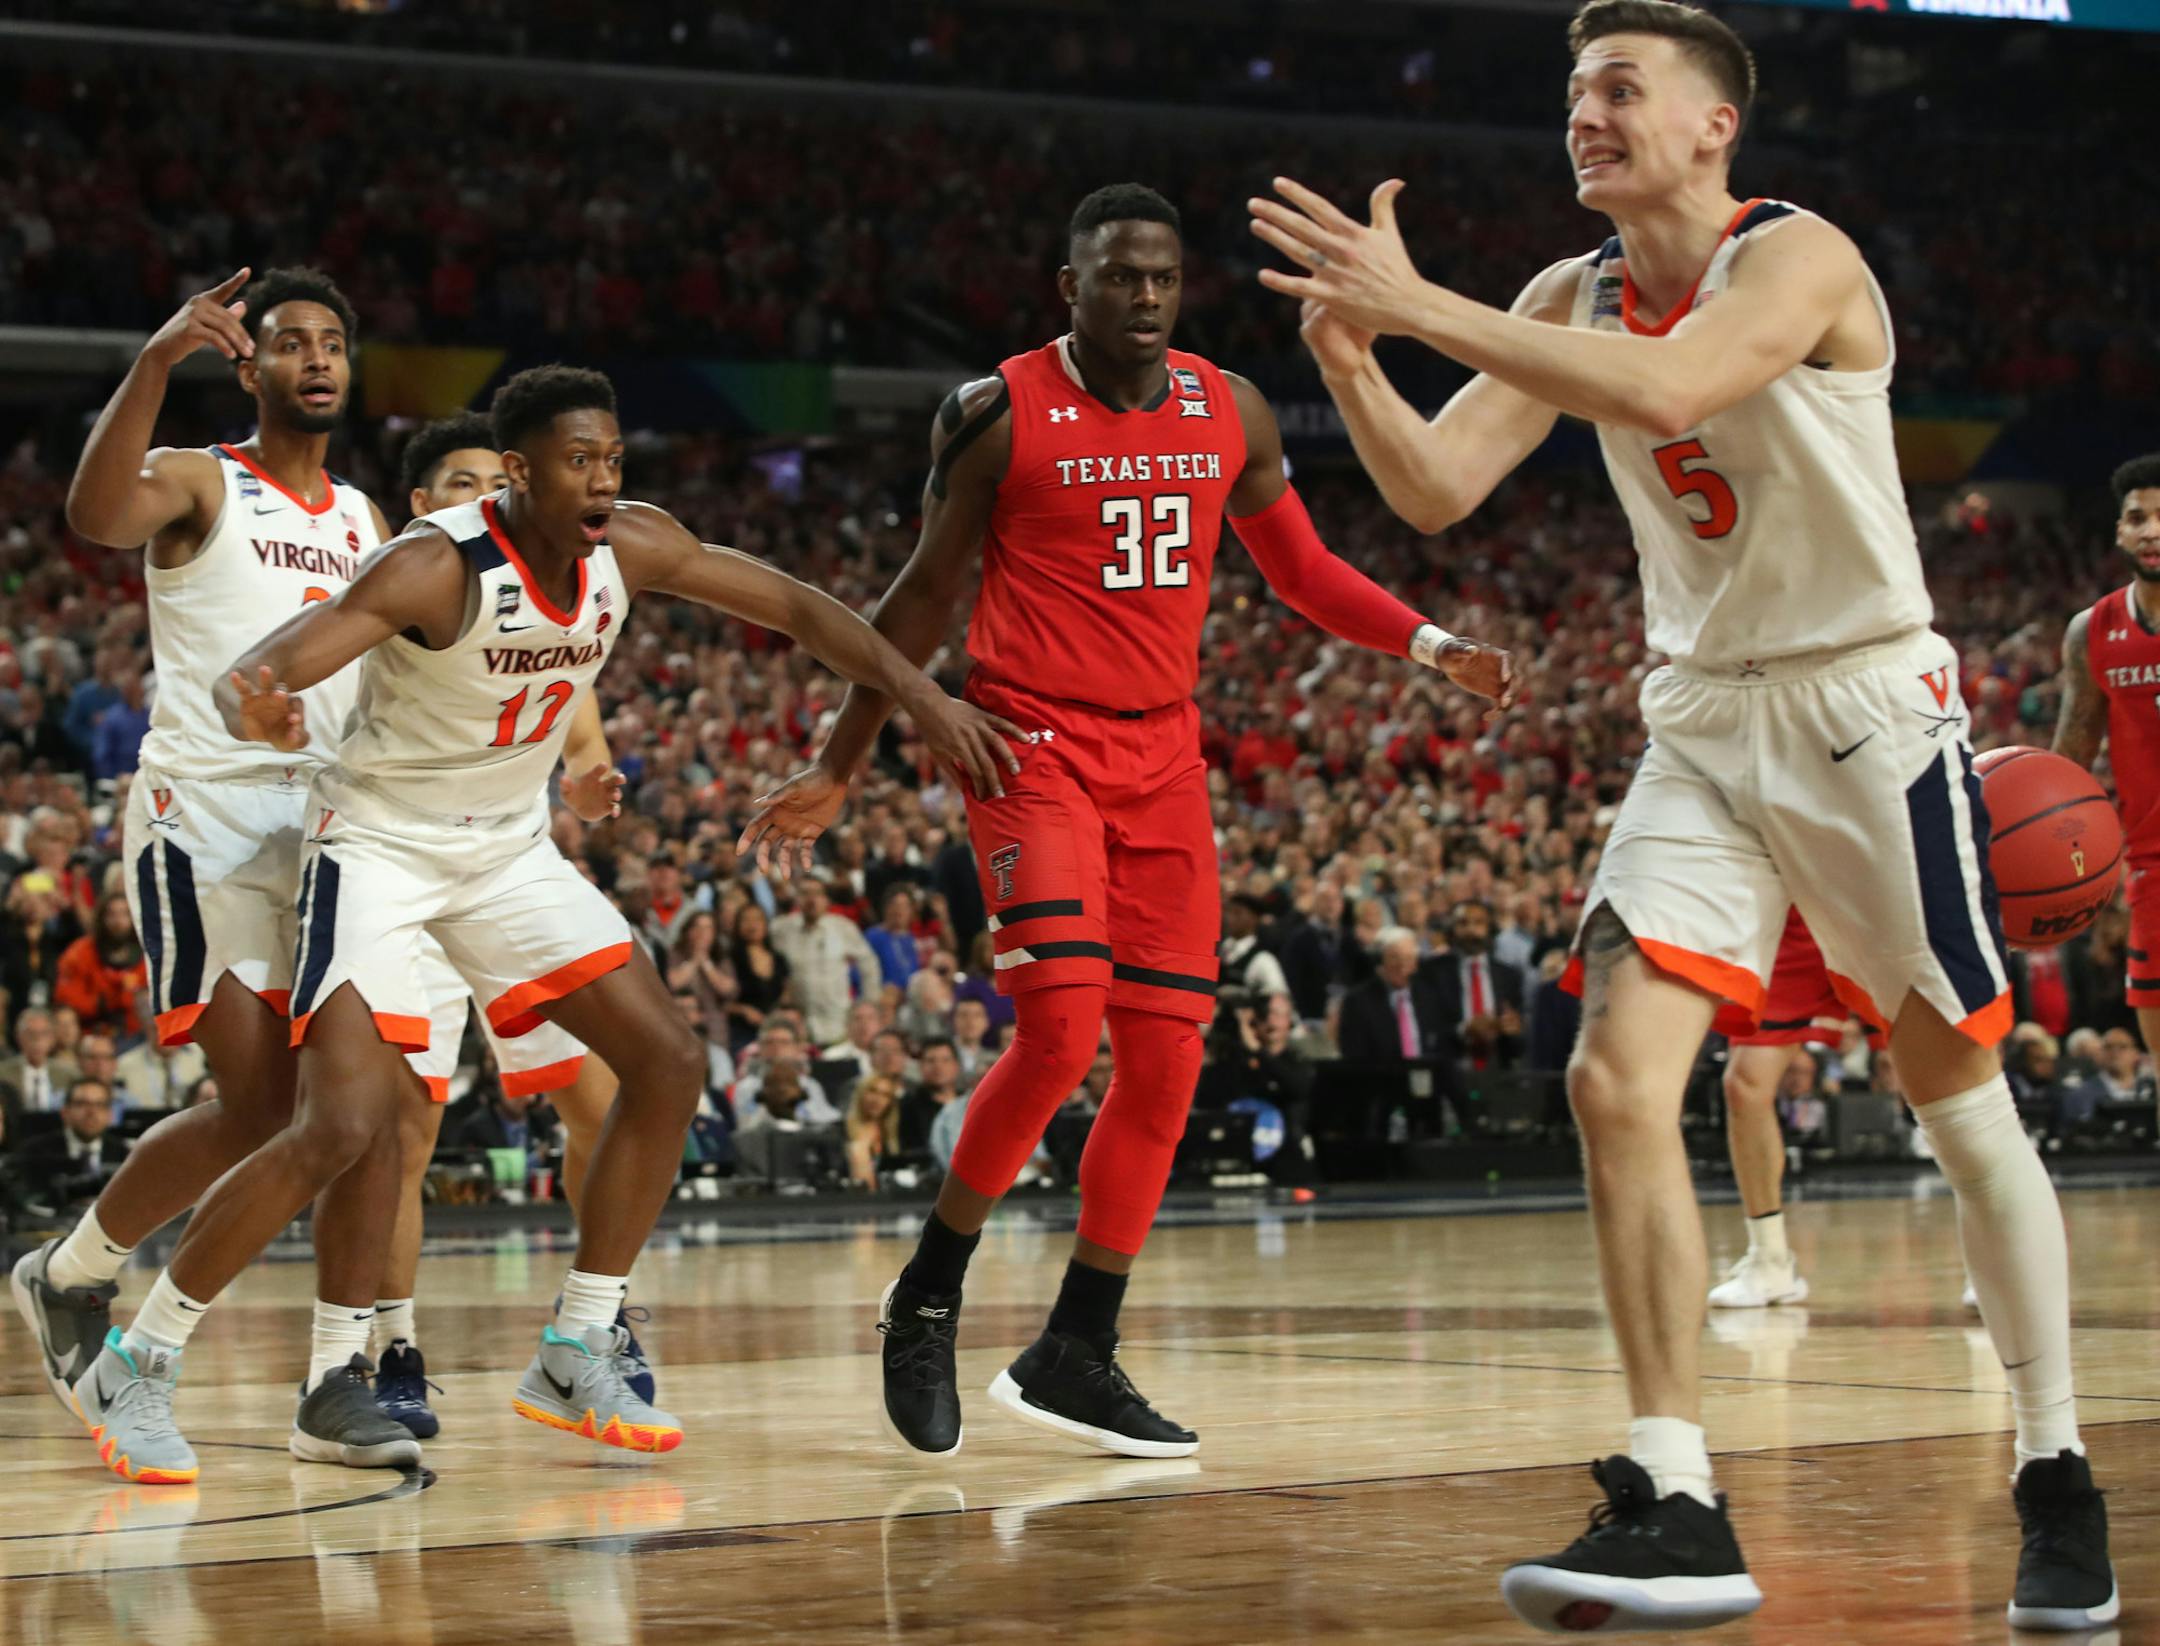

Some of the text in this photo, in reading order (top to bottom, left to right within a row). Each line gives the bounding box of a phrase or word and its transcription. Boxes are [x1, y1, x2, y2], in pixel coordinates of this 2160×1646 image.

[1055, 453, 1222, 485] TEXAS TECH
[1651, 437, 1738, 540] 5
[1101, 494, 1191, 590] 32
[482, 638, 604, 676] VIRGINIA
[487, 679, 575, 748] 12
